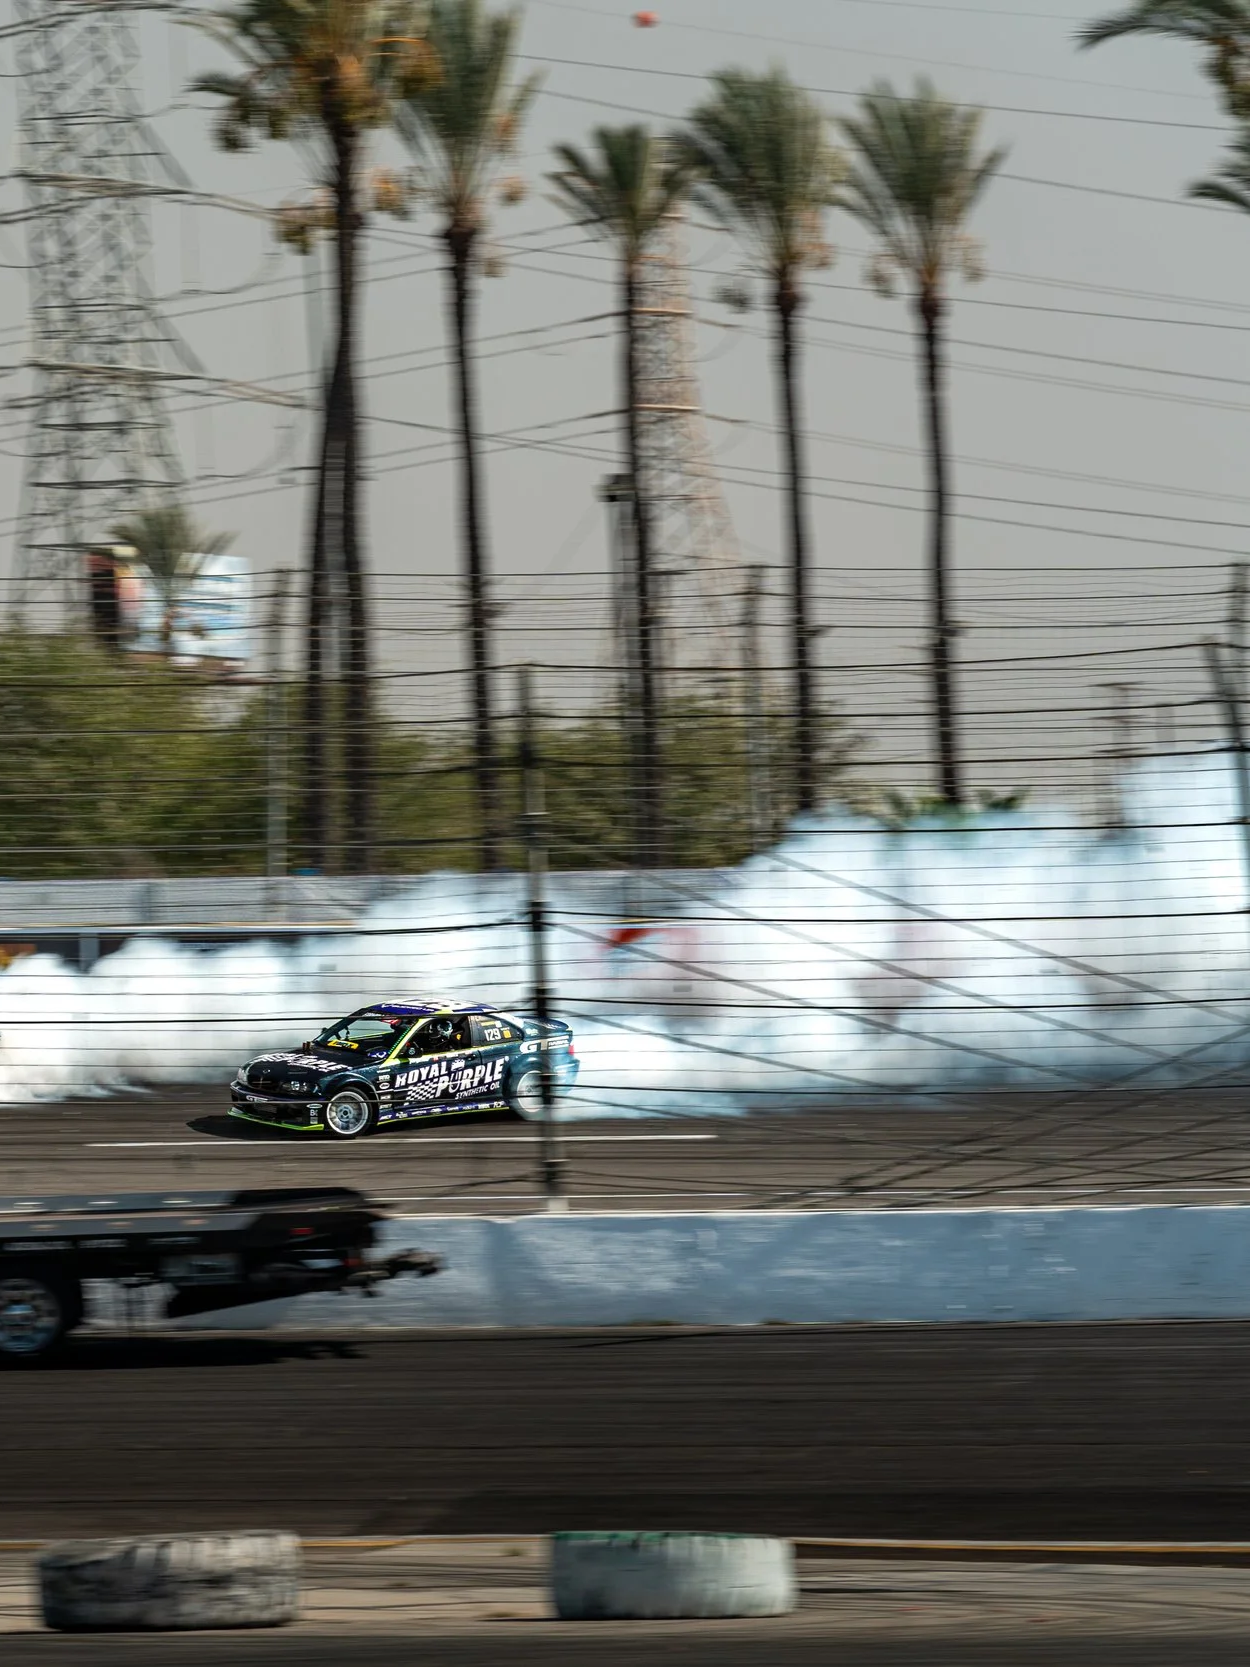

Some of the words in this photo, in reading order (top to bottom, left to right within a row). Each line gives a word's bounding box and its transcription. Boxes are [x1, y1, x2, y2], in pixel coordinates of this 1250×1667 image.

[483, 1028, 501, 1041] 129
[395, 1060, 448, 1088] ROYAL
[435, 1058, 505, 1097] PURPLE
[455, 1087, 488, 1100] SYNTHETIC
[490, 1081, 500, 1090] OIL
